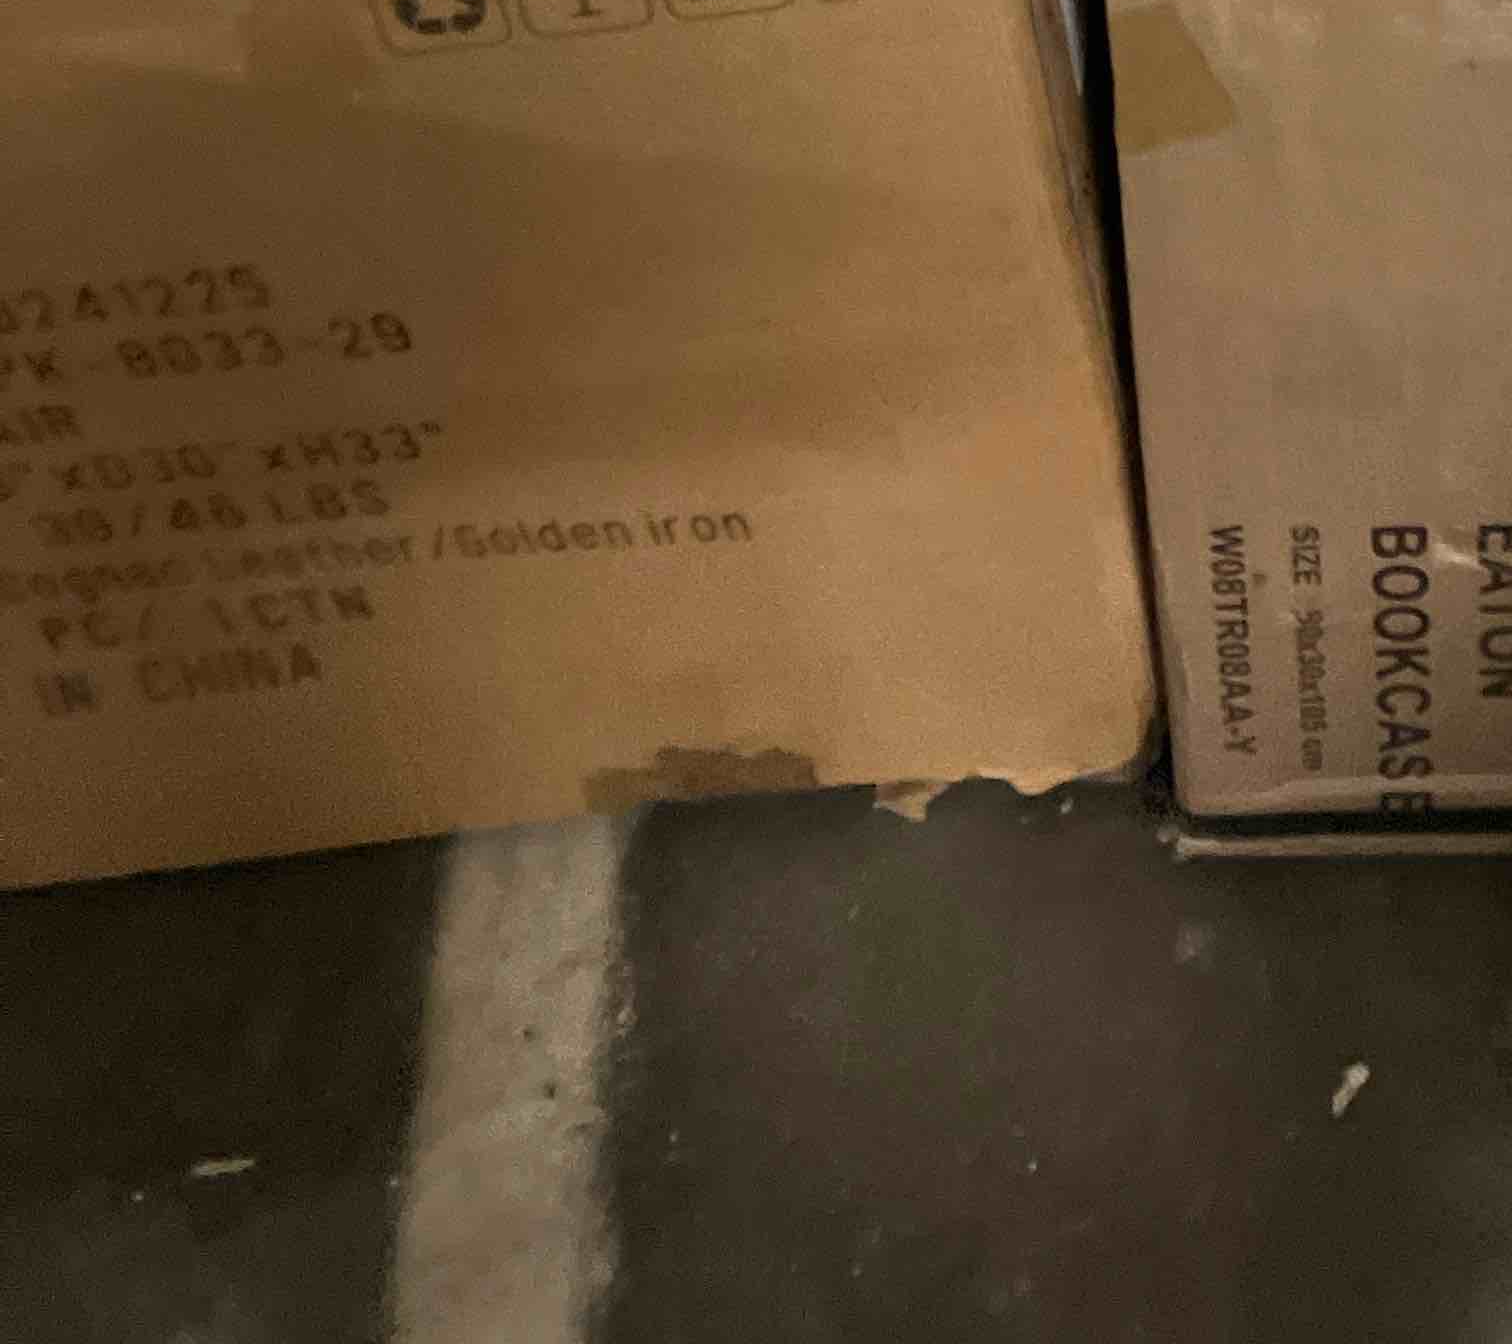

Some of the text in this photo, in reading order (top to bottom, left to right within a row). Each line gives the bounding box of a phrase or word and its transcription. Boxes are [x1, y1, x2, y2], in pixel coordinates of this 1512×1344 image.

[1290, 525, 1323, 586] SIZE
[137, 643, 323, 703] CHINA
[1208, 524, 1259, 758] W08TR08AA-Y
[1371, 524, 1435, 817] BOOKCASE
